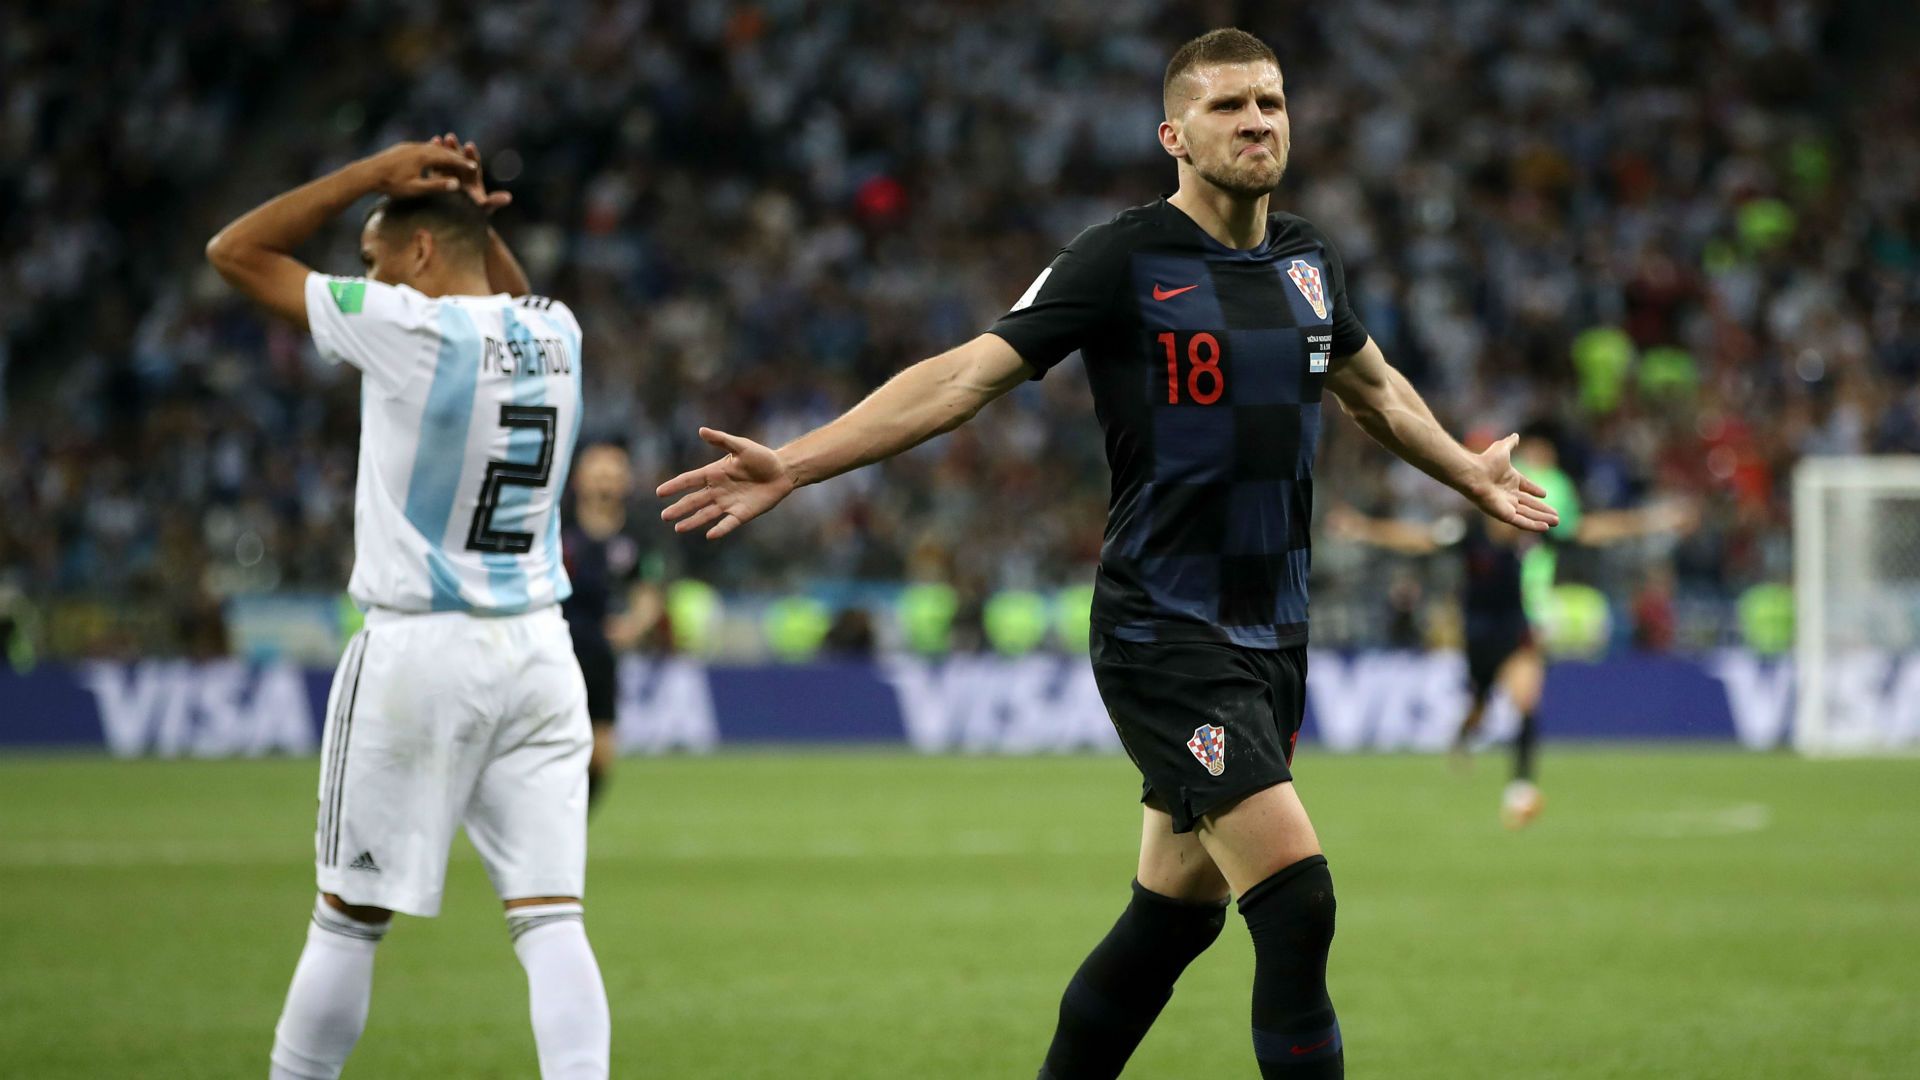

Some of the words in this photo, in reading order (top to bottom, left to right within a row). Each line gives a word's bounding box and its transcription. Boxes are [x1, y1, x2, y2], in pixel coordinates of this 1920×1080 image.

[484, 336, 569, 376] MERCADO
[1158, 331, 1224, 405] 18
[466, 404, 557, 553] 2
[84, 657, 318, 757] VISA
